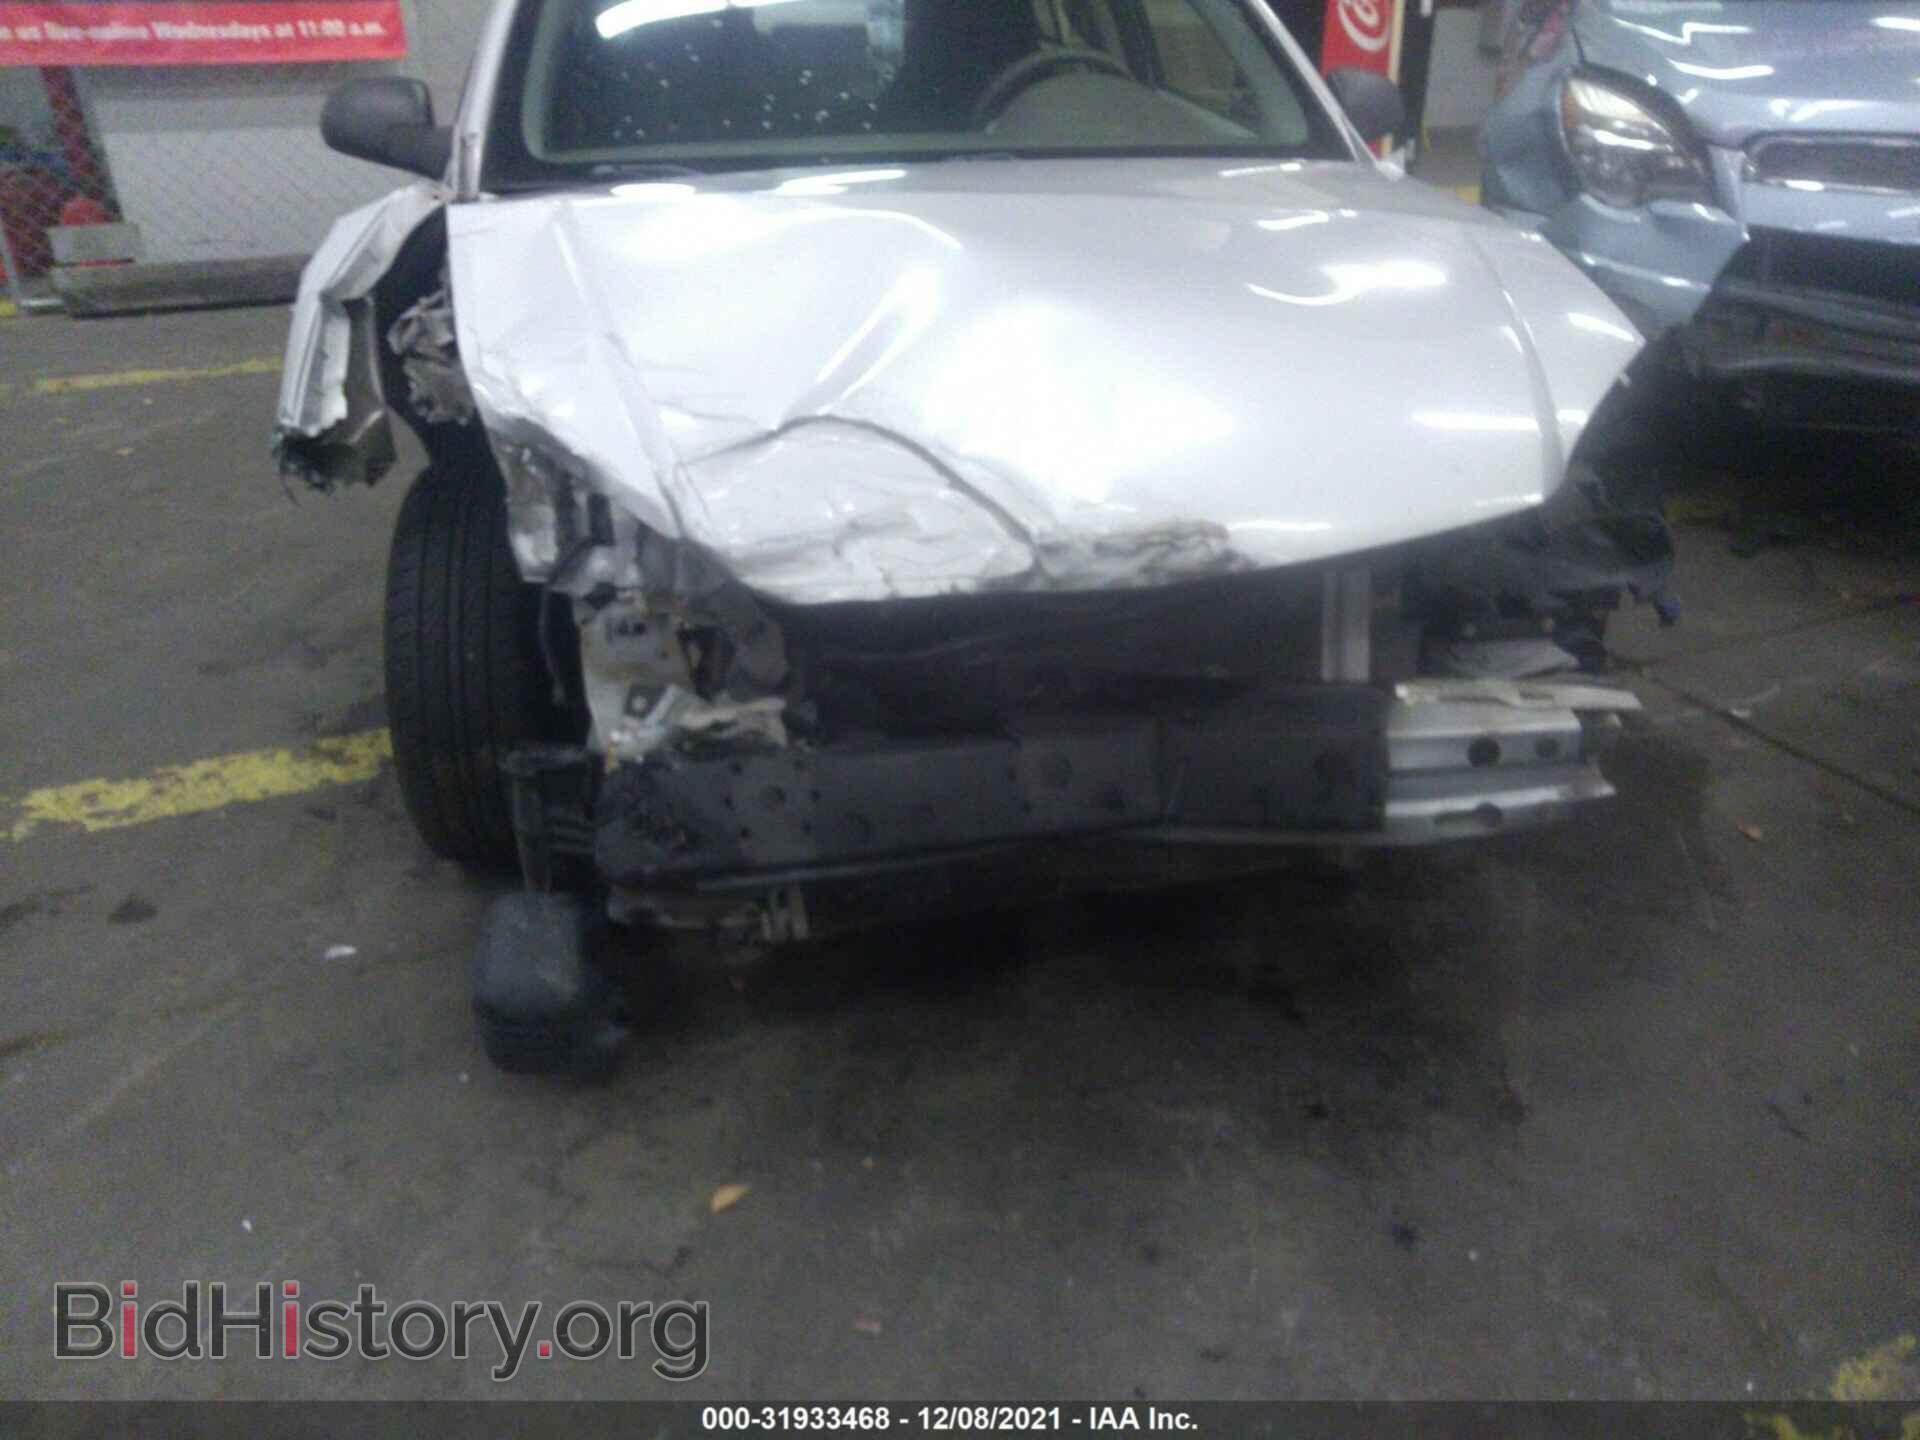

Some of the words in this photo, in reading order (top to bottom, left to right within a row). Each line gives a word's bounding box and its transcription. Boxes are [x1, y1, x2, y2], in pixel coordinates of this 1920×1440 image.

[151, 21, 271, 43] Wednesdays
[274, 22, 295, 39] at
[297, 19, 346, 39] 11:00
